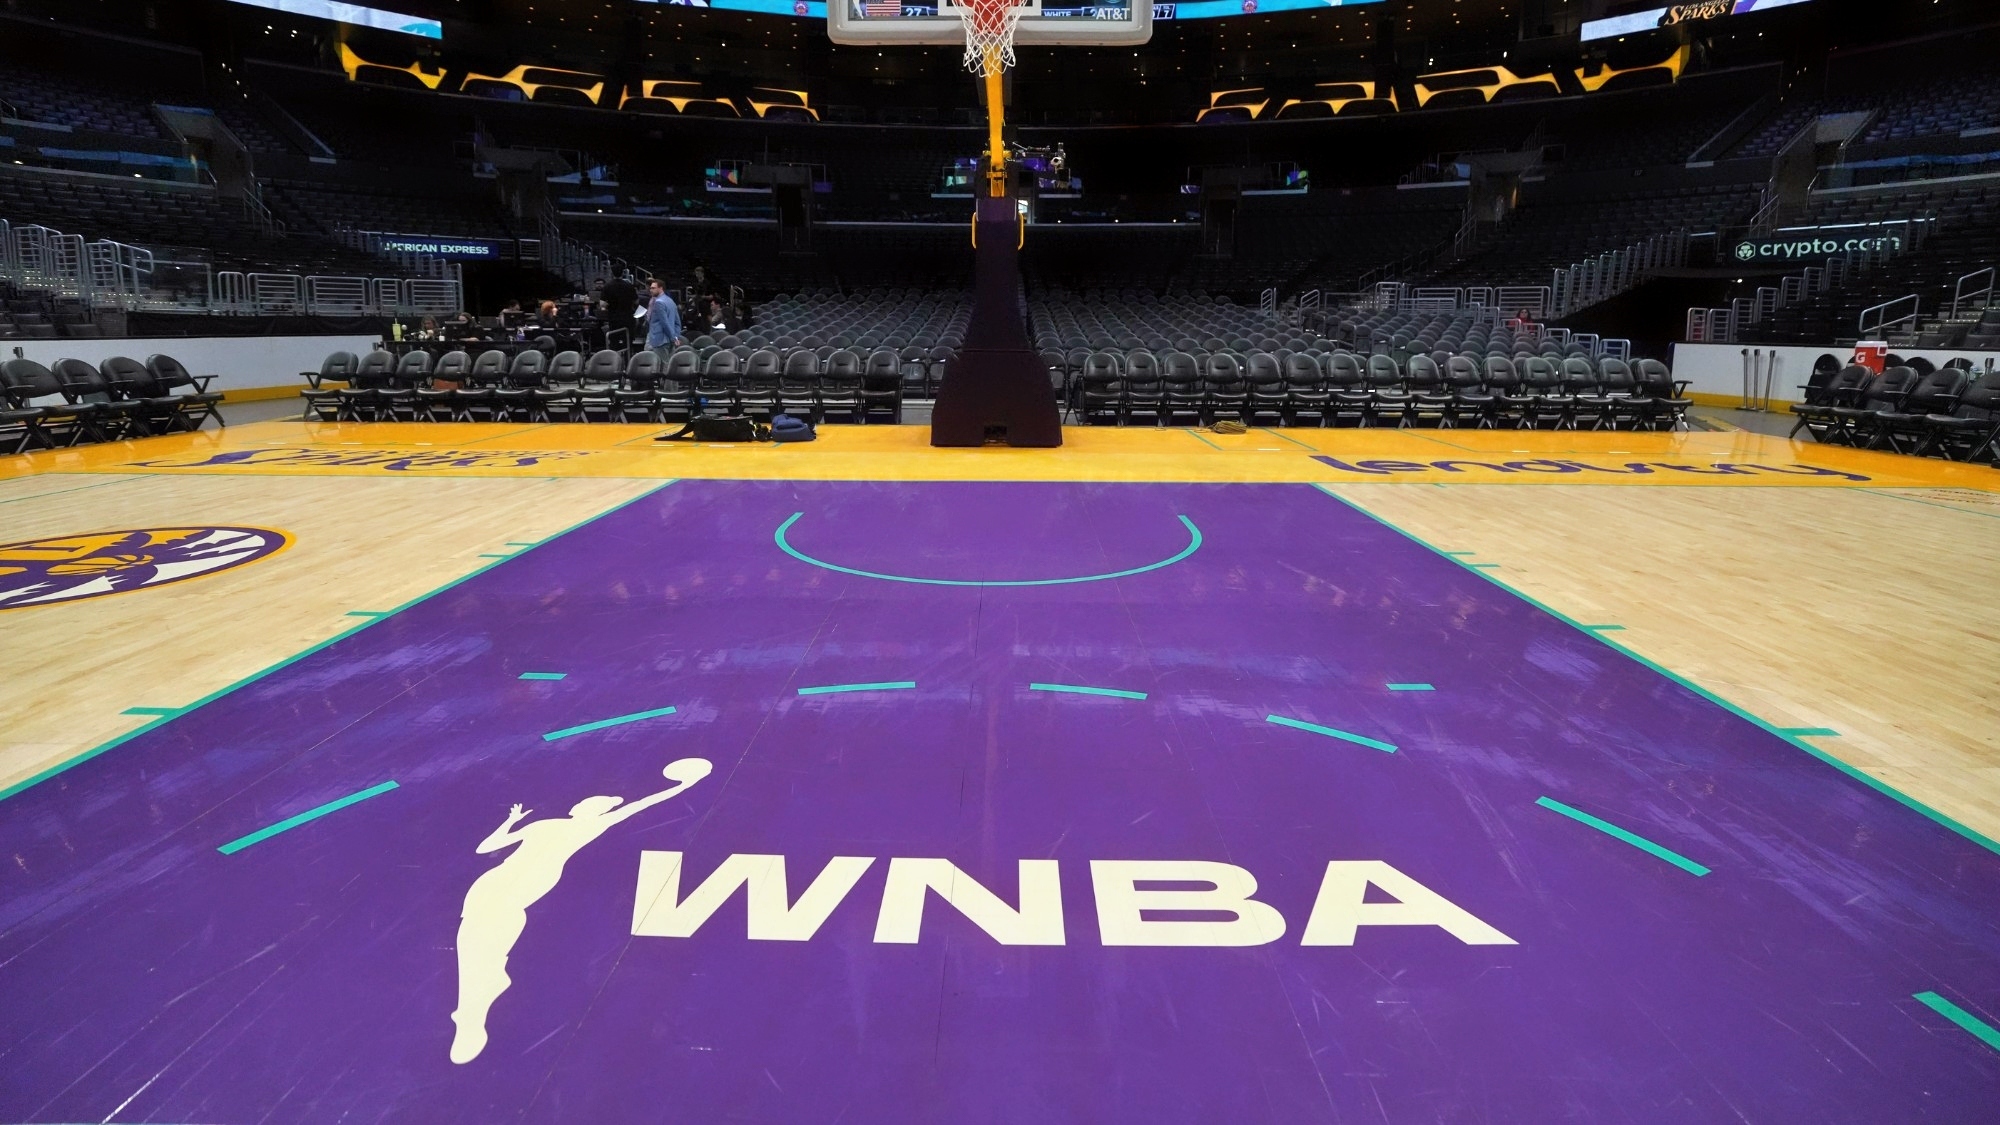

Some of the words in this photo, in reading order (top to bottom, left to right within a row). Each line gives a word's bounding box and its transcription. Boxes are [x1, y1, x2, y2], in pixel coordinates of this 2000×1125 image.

[1095, 7, 1131, 20] AT&T
[1163, 10, 1170, 18] 7
[1664, 4, 1727, 26] SPARKS
[440, 244, 490, 255] EXPRESS
[1855, 351, 1867, 364] G
[1308, 454, 1872, 482] lendistry
[630, 850, 1520, 947] WNBA
